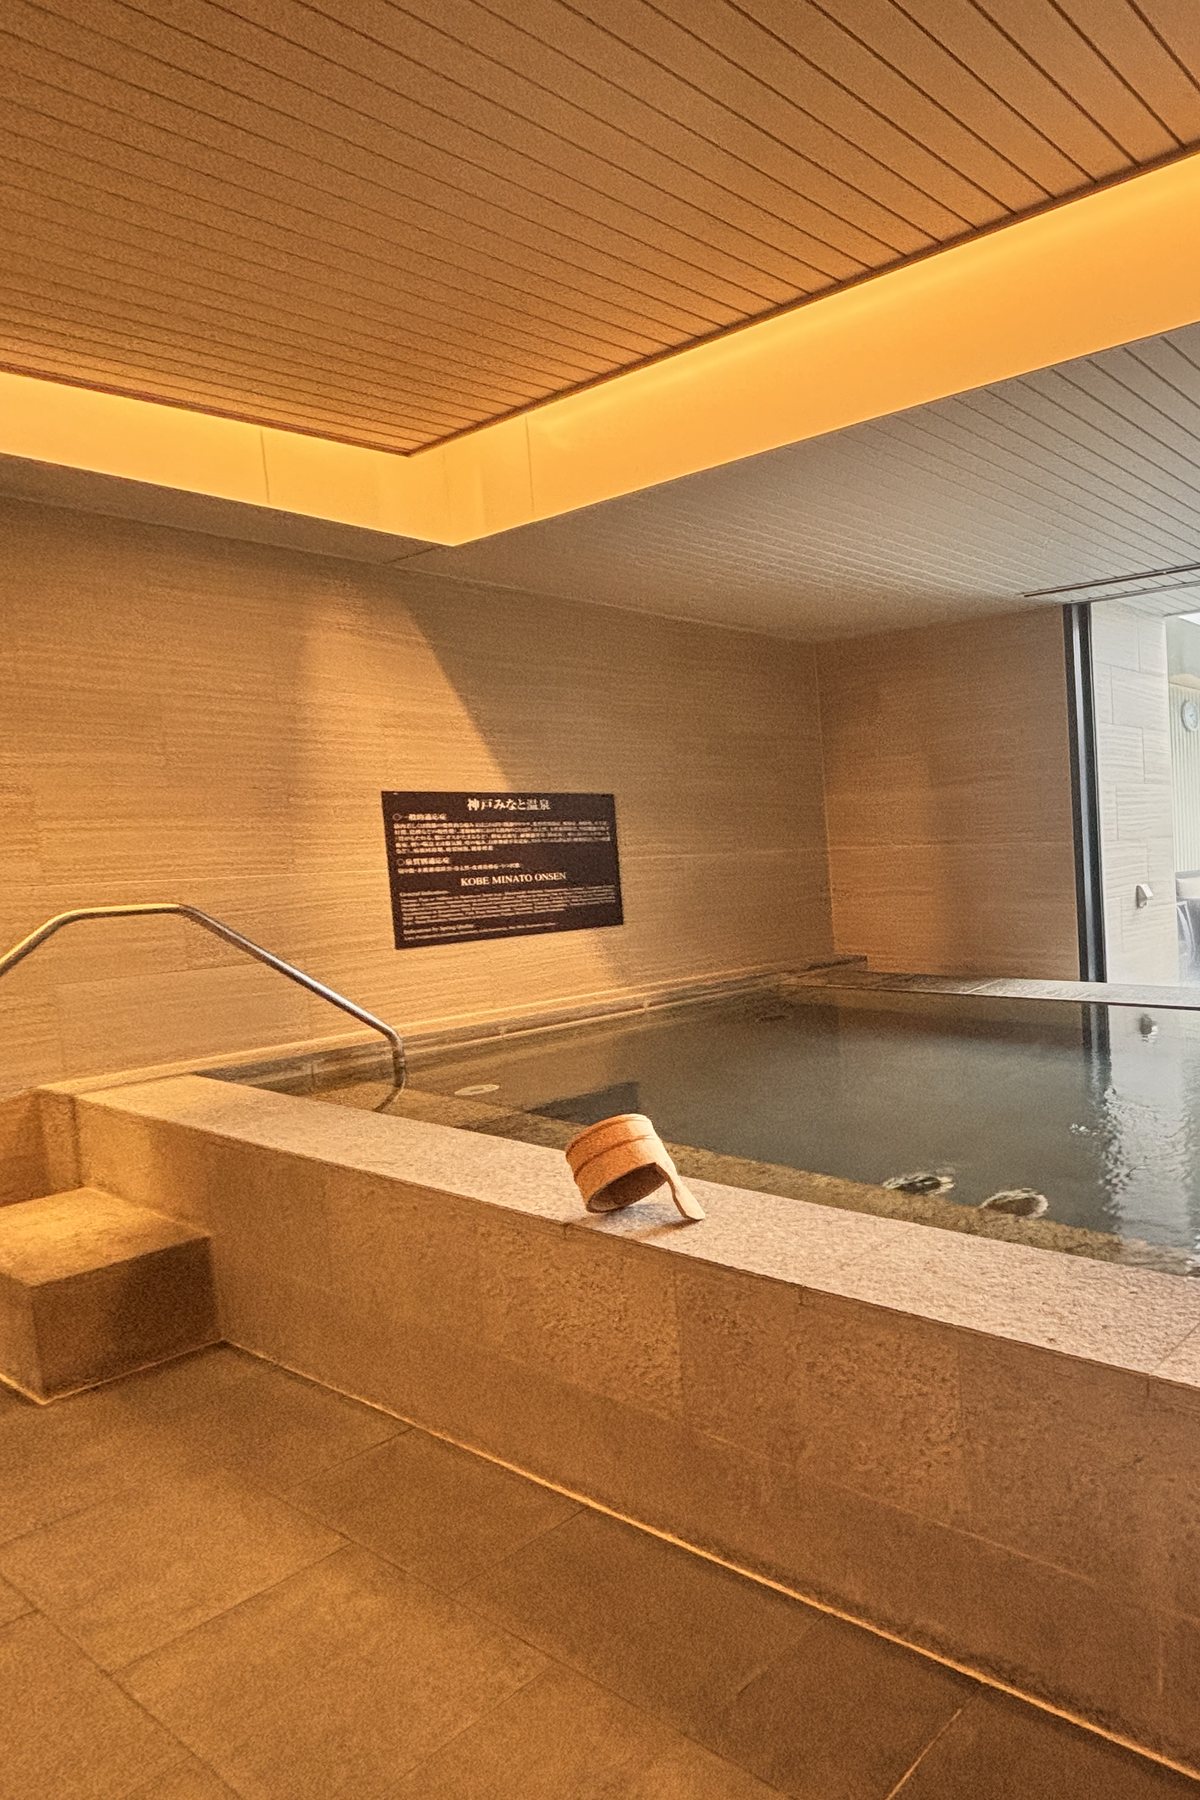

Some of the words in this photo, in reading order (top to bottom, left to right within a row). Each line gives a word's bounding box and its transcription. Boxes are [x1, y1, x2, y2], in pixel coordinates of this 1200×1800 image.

[467, 798, 551, 811] 神戸みなと温泉
[461, 877, 490, 887] KOBE
[492, 875, 533, 886] MINATO
[535, 872, 567, 882] ONSEN
